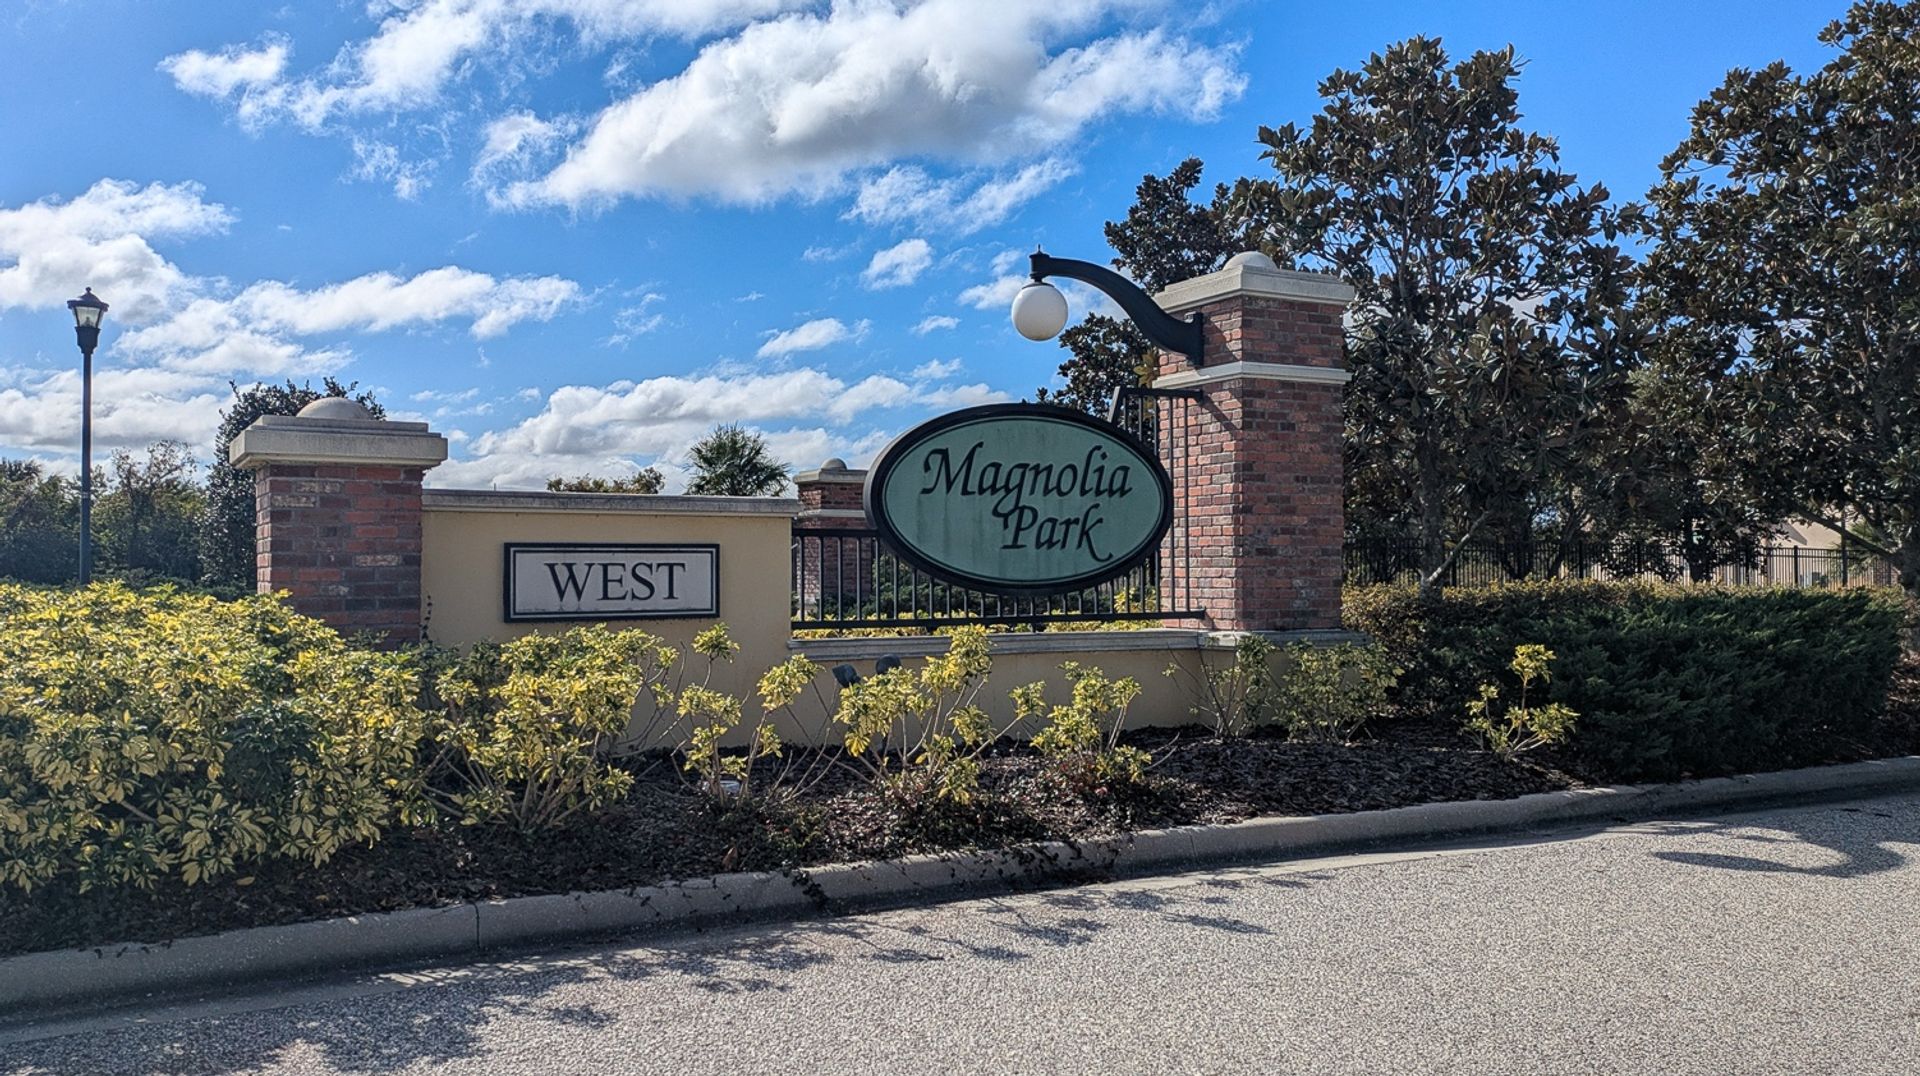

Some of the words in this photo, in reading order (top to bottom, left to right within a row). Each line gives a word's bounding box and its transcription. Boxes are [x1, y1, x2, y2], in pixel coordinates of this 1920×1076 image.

[920, 441, 1133, 517] Magnolia
[1001, 503, 1114, 562] Park
[544, 562, 686, 601] WEST
